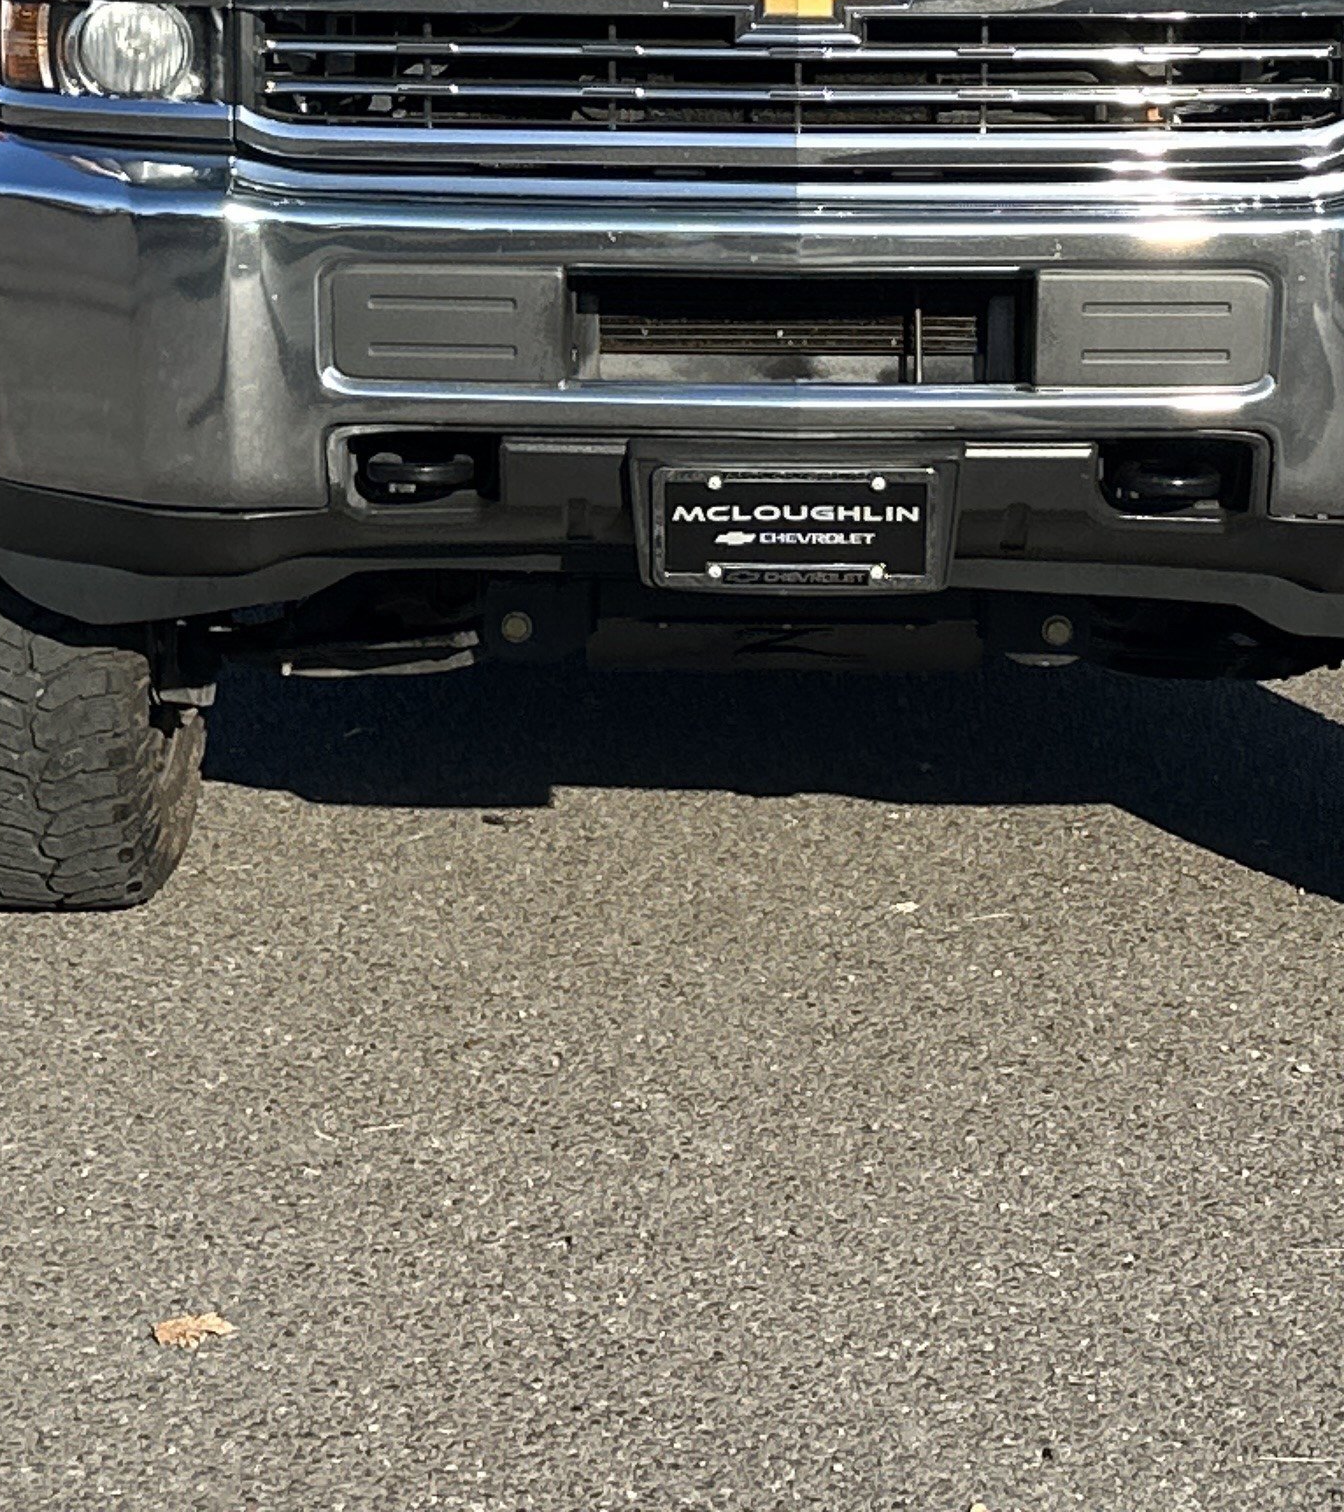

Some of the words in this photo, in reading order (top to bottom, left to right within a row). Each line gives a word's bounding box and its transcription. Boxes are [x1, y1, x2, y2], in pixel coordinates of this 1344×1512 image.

[672, 505, 920, 522] MCLOUGHLIN
[759, 532, 876, 545] CHEVROLET
[763, 571, 868, 584] CHEVROLET
